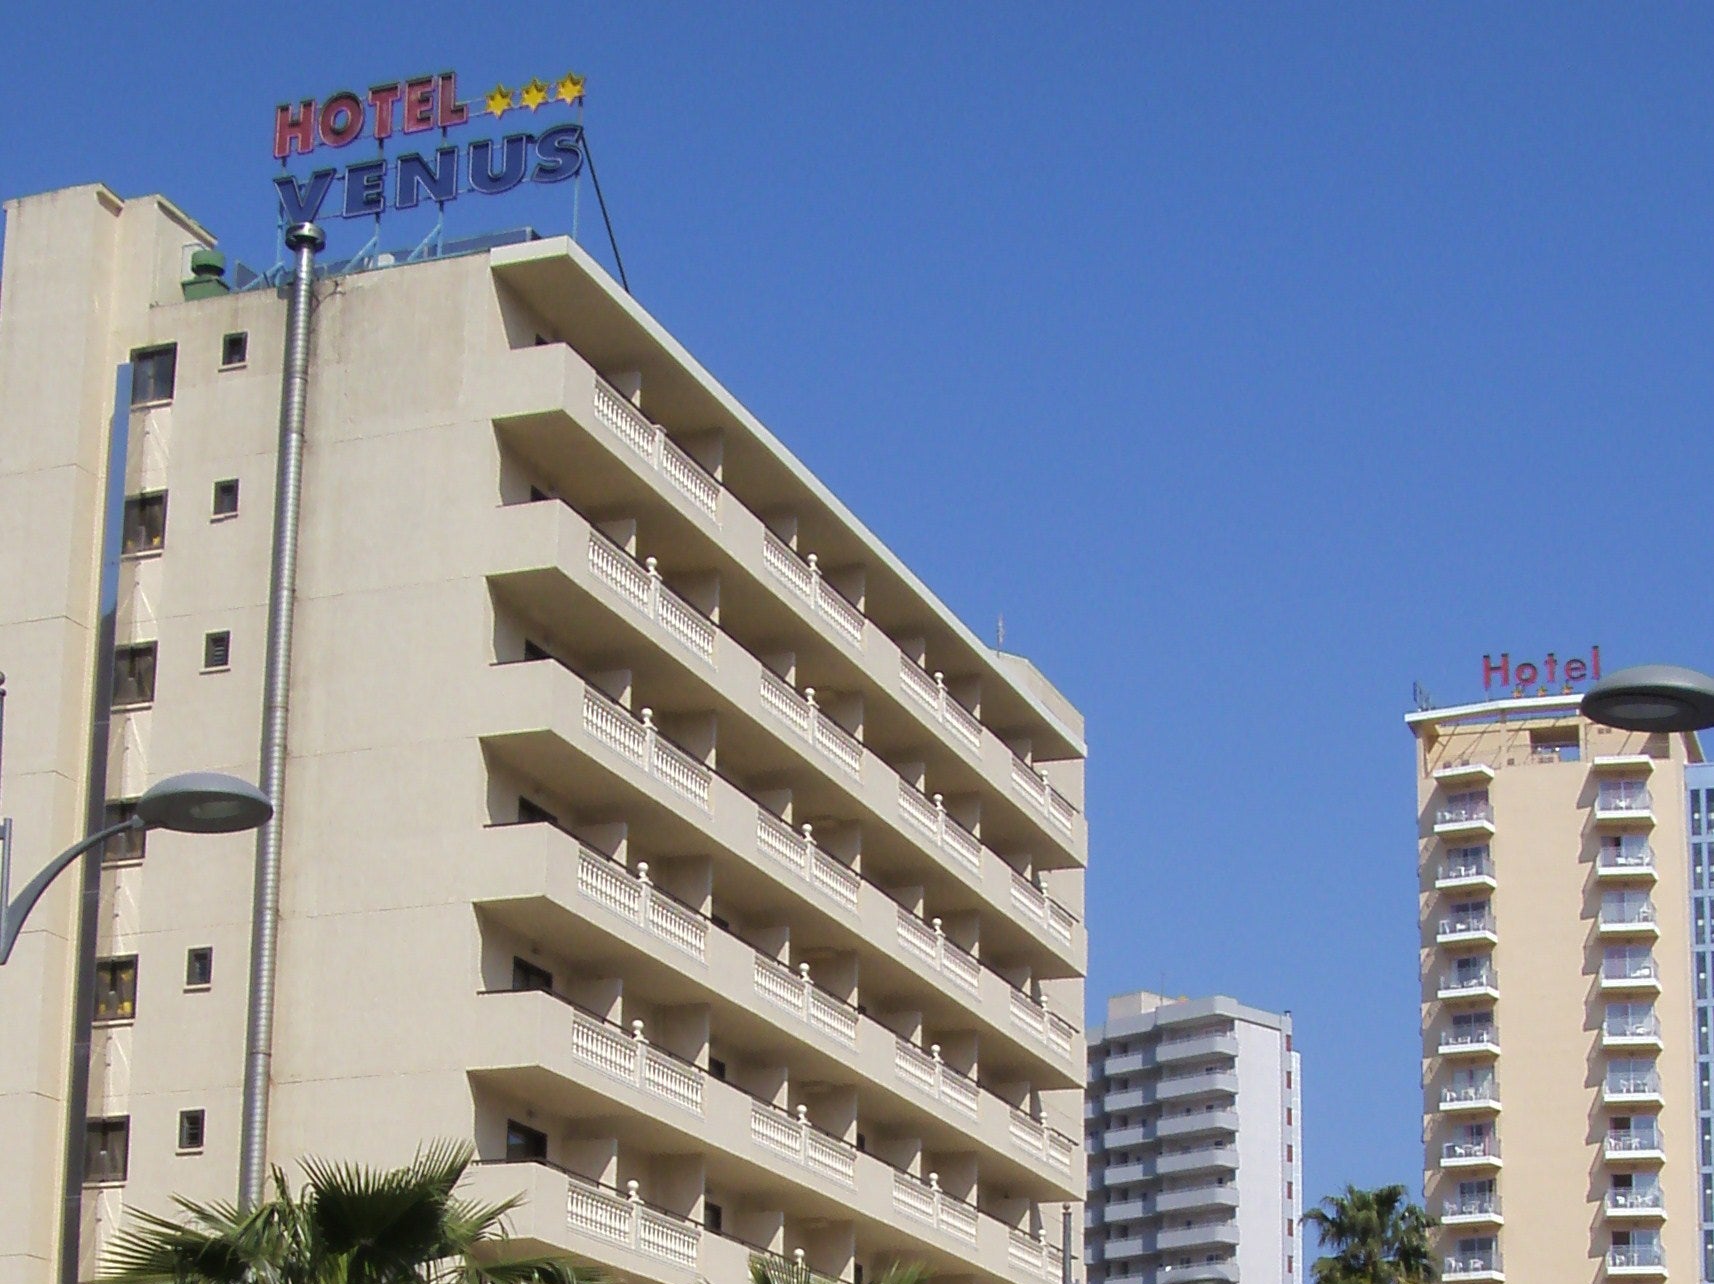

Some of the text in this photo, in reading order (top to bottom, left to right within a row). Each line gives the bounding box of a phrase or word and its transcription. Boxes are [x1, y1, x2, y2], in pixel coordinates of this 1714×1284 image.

[273, 71, 468, 159] HOTEL
[273, 124, 583, 226] VENUS
[1482, 645, 1600, 689] Hotel
